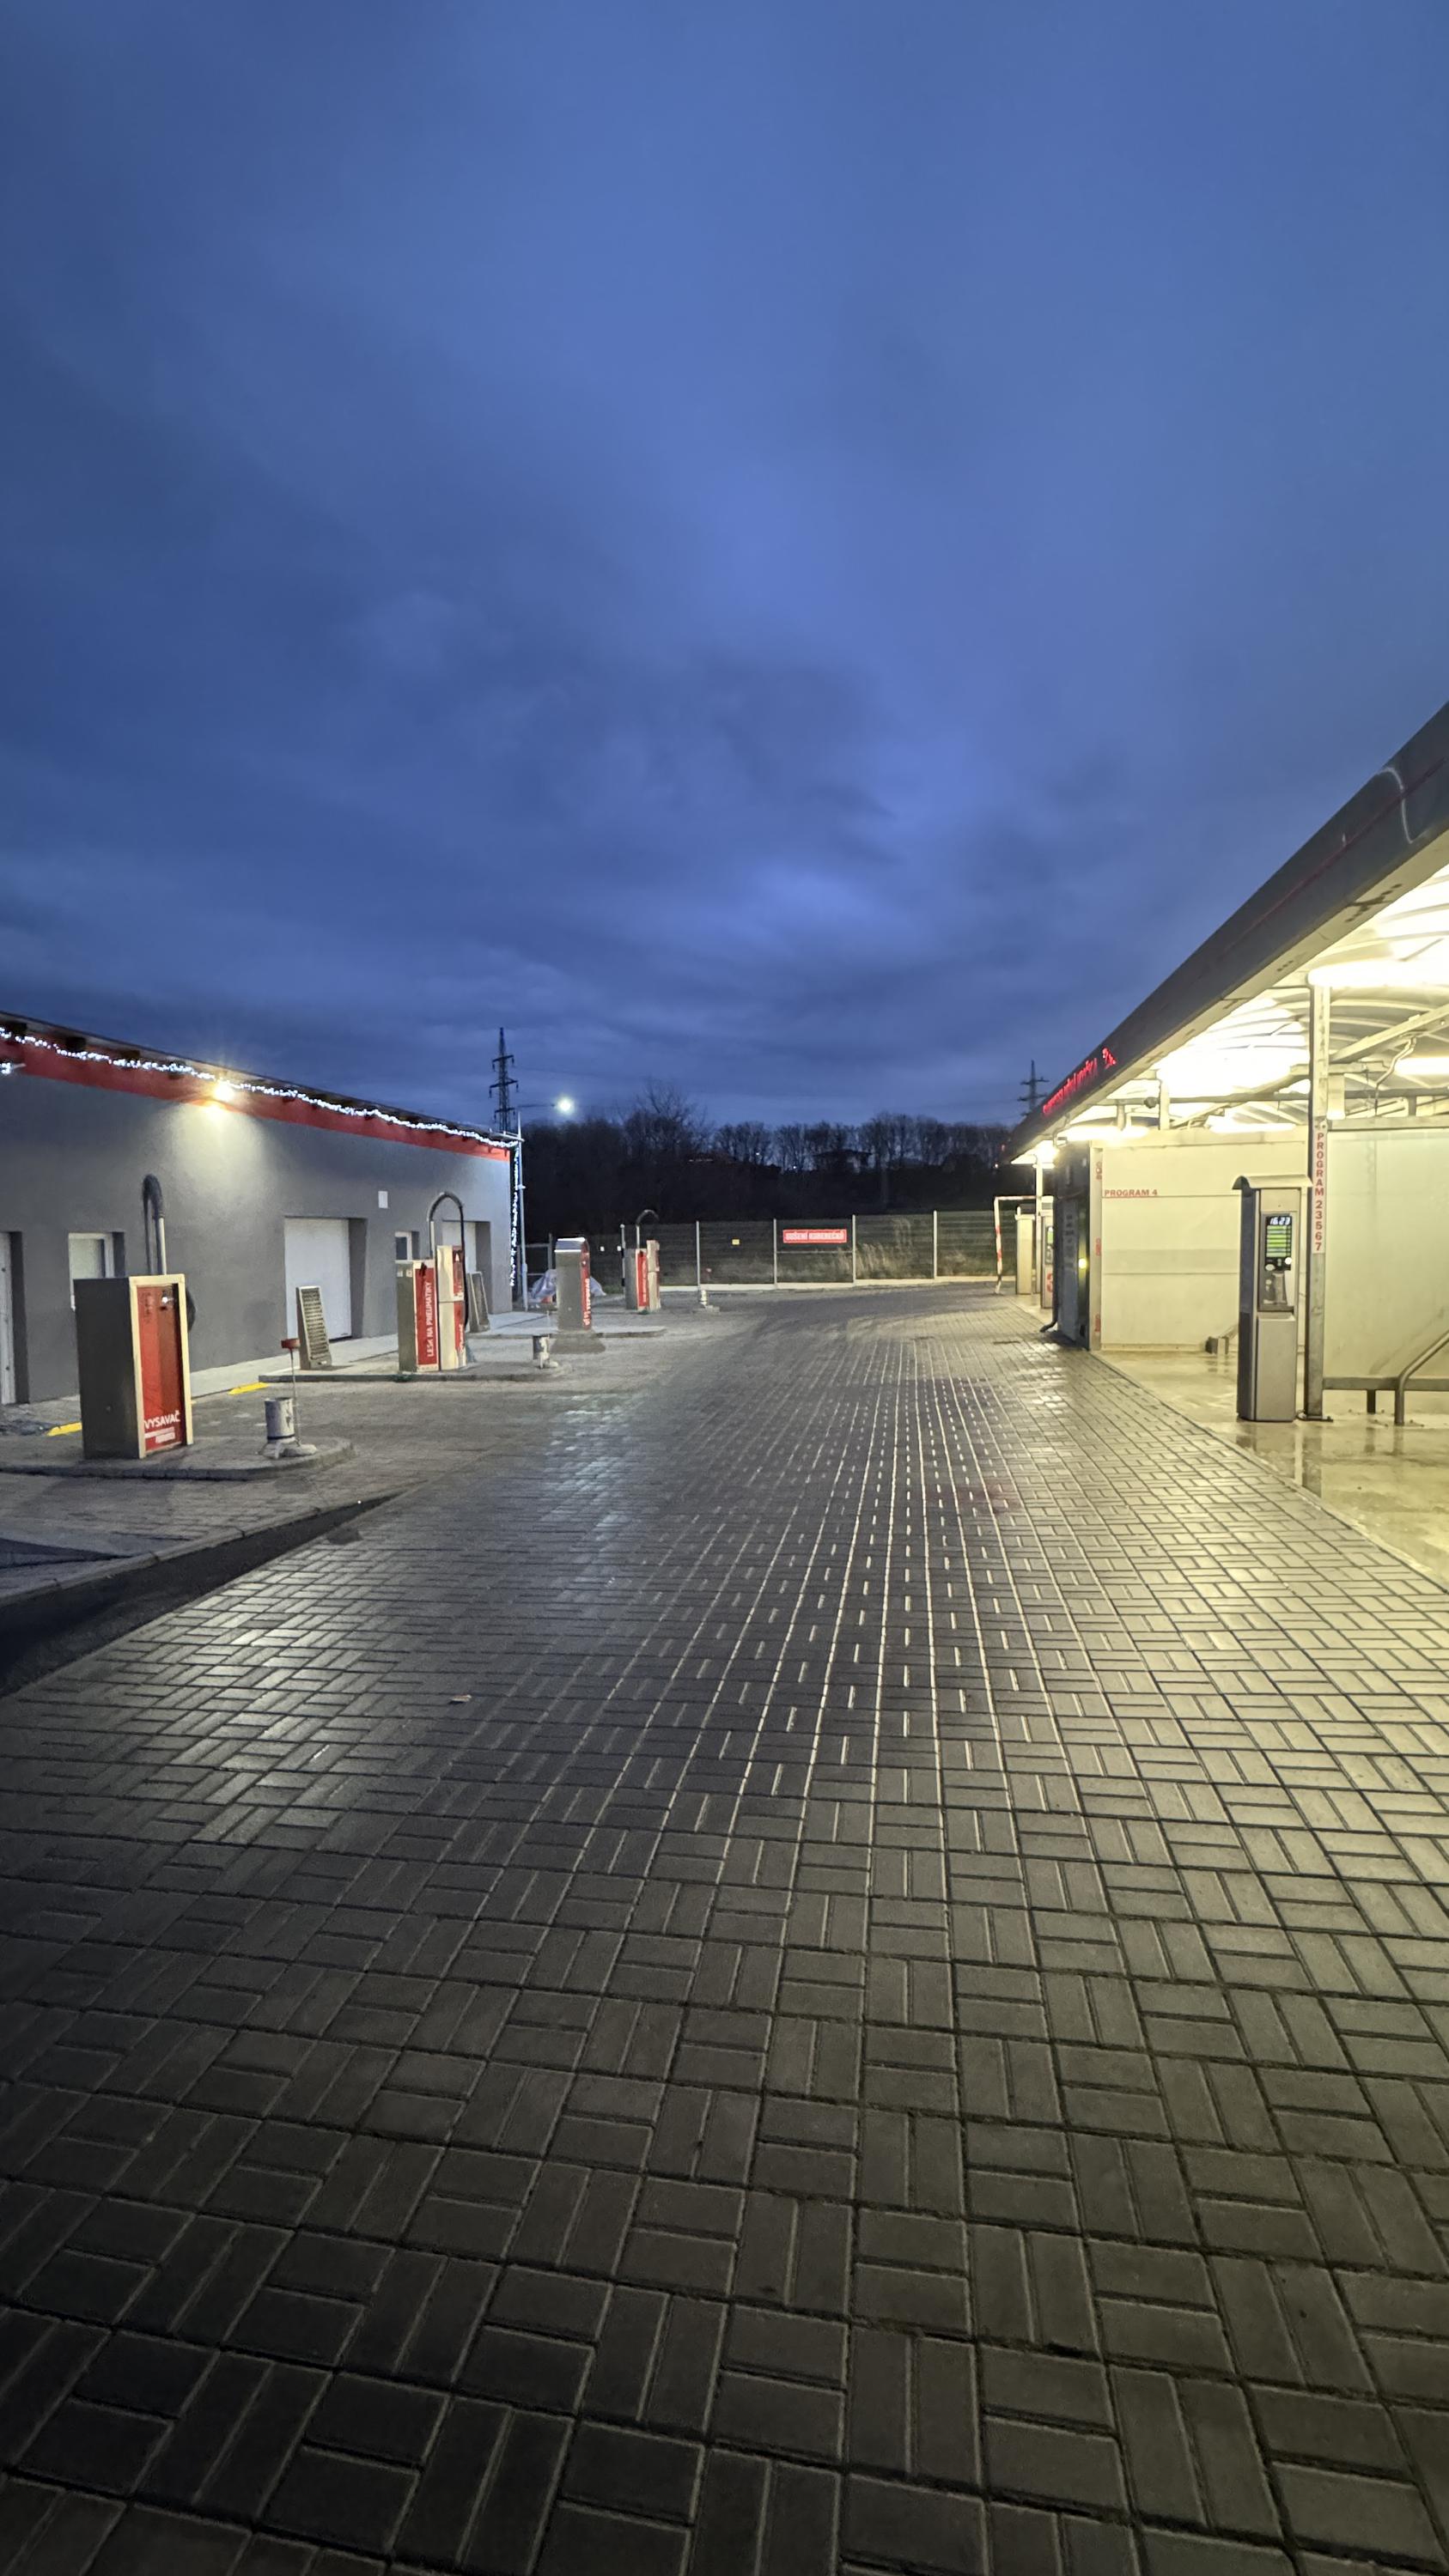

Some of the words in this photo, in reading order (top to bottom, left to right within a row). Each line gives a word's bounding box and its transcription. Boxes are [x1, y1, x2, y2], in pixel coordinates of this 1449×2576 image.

[1315, 1133, 1324, 1196] PROGRAM
[1314, 1200, 1323, 1251] 23567
[424, 1281, 433, 1326] PNEUMATIKY
[426, 1326, 434, 1338] NA
[144, 1410, 180, 1430] VYSAVAČ
